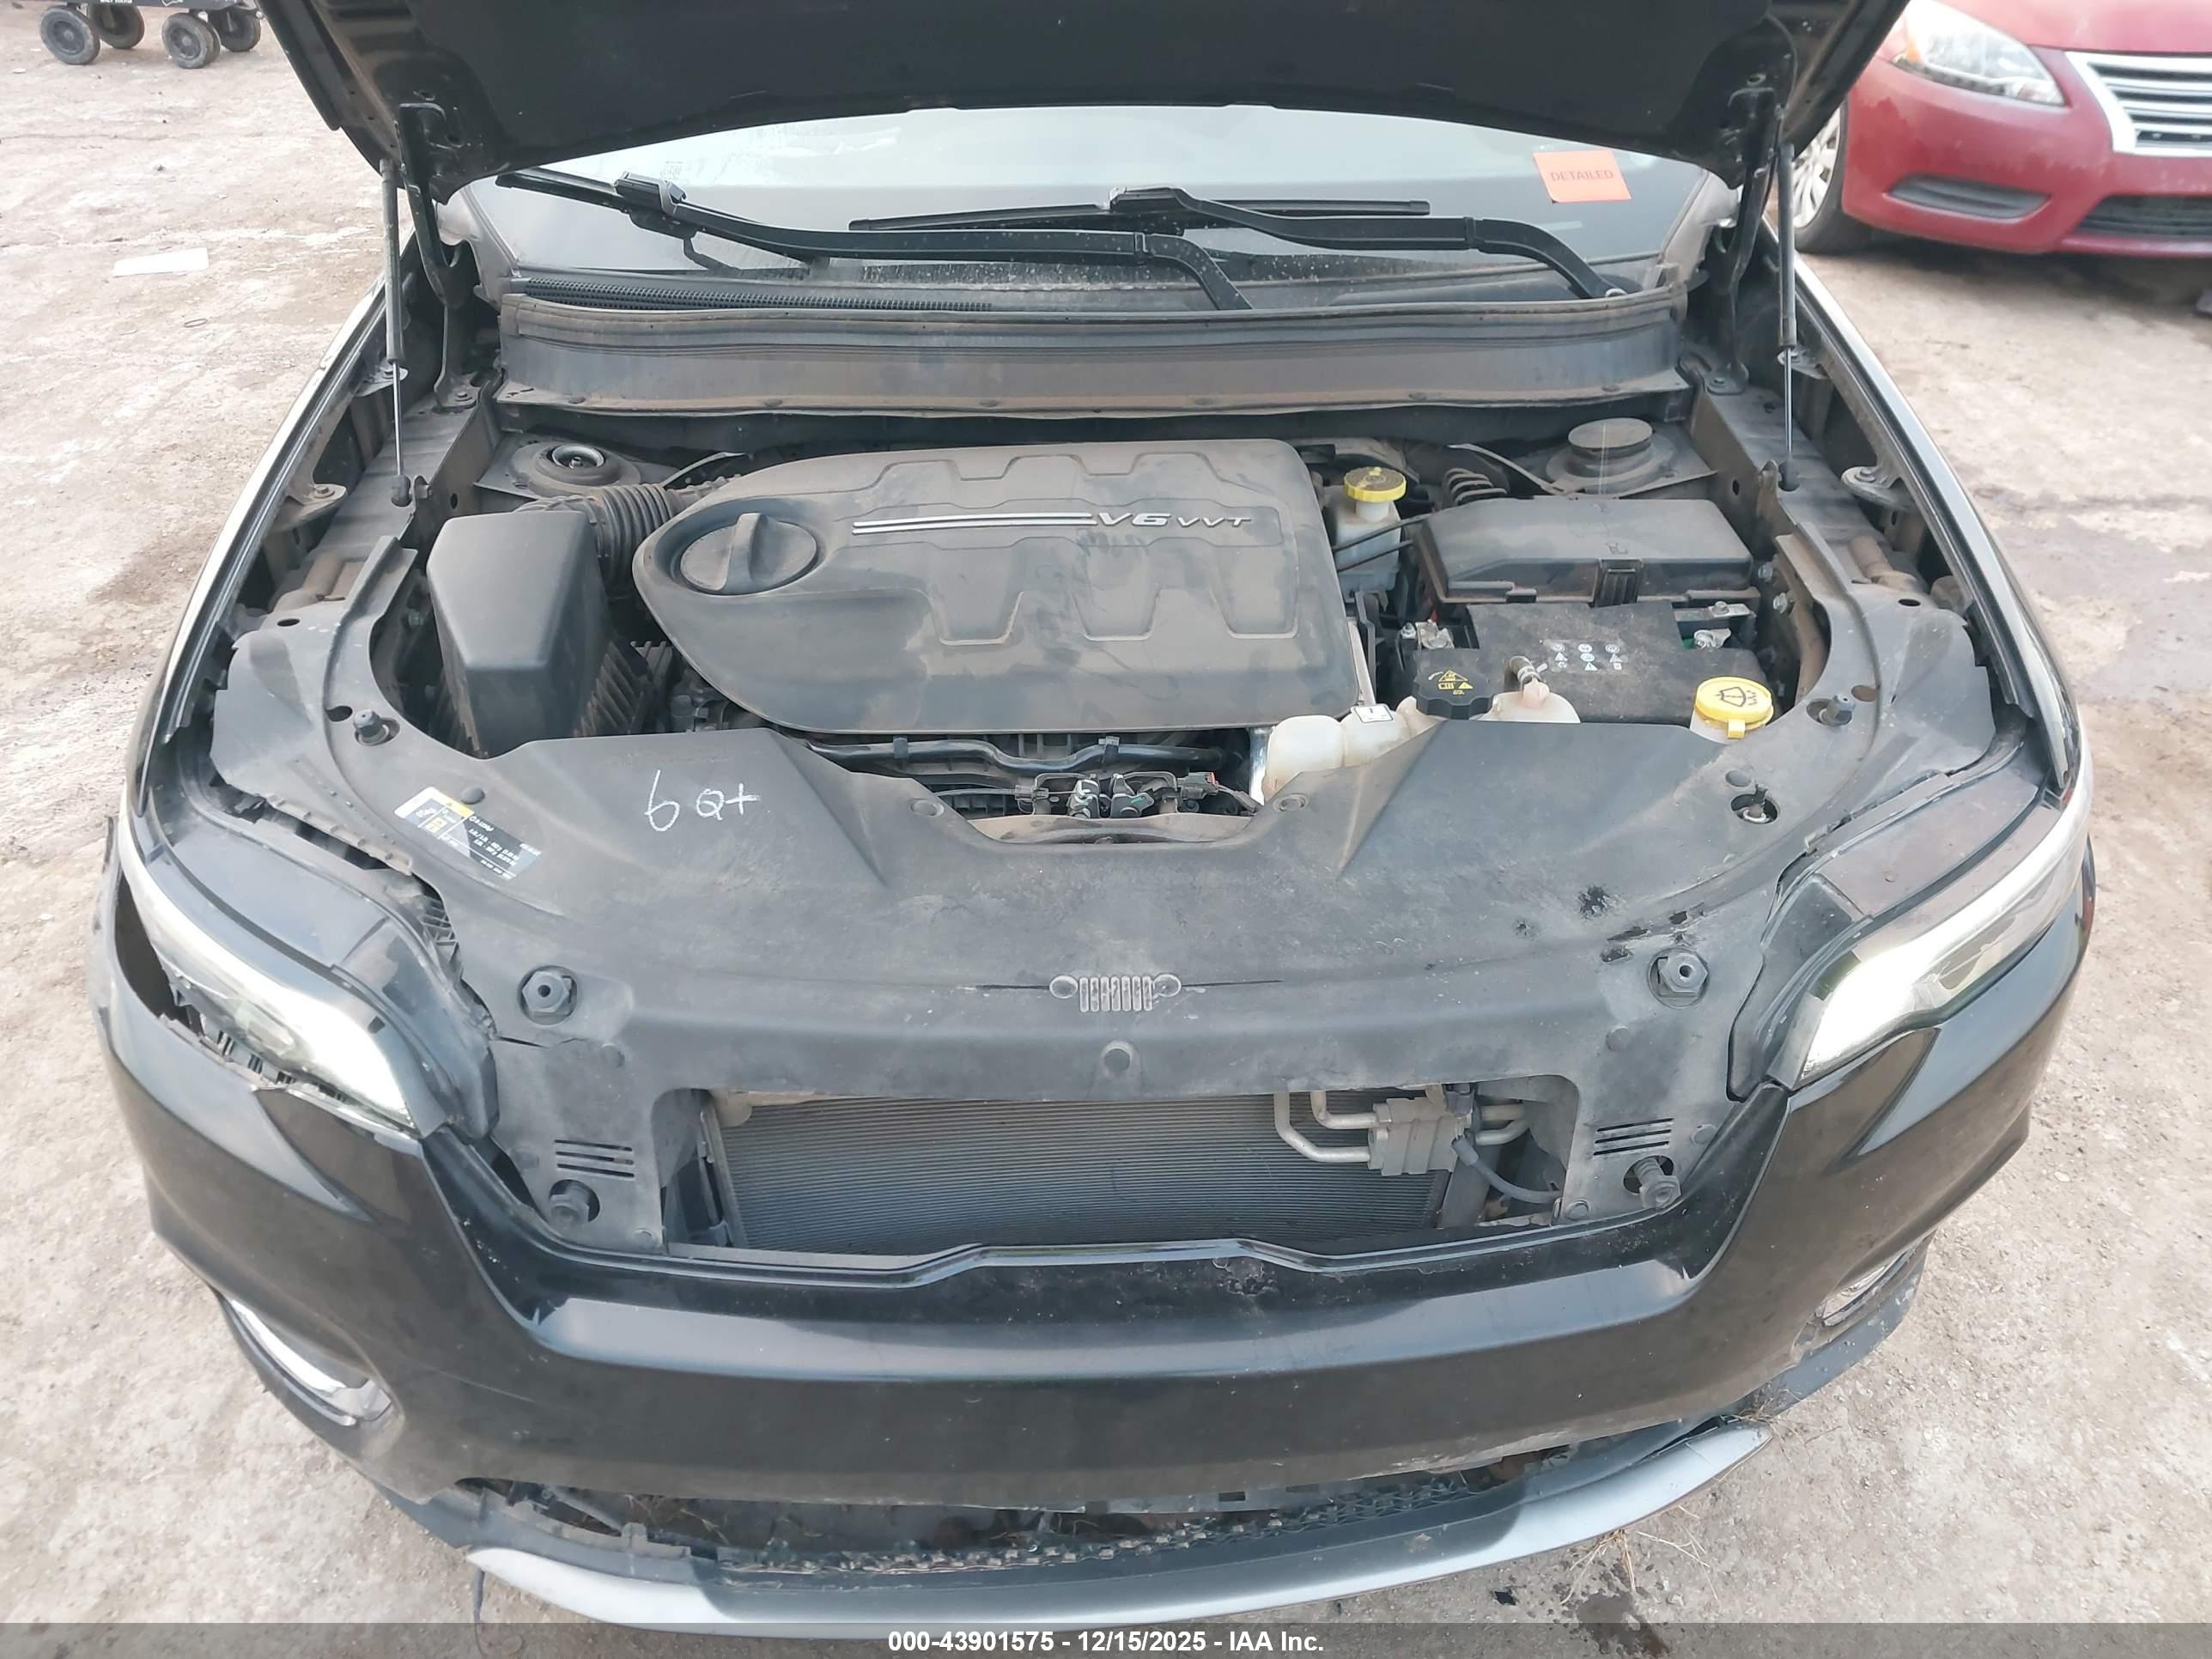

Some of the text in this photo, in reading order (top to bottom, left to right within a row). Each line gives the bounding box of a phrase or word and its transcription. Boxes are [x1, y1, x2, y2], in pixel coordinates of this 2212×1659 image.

[1551, 169, 1613, 181] DETAILED
[1098, 512, 1251, 528] V6 VVT
[644, 769, 680, 831] 6
